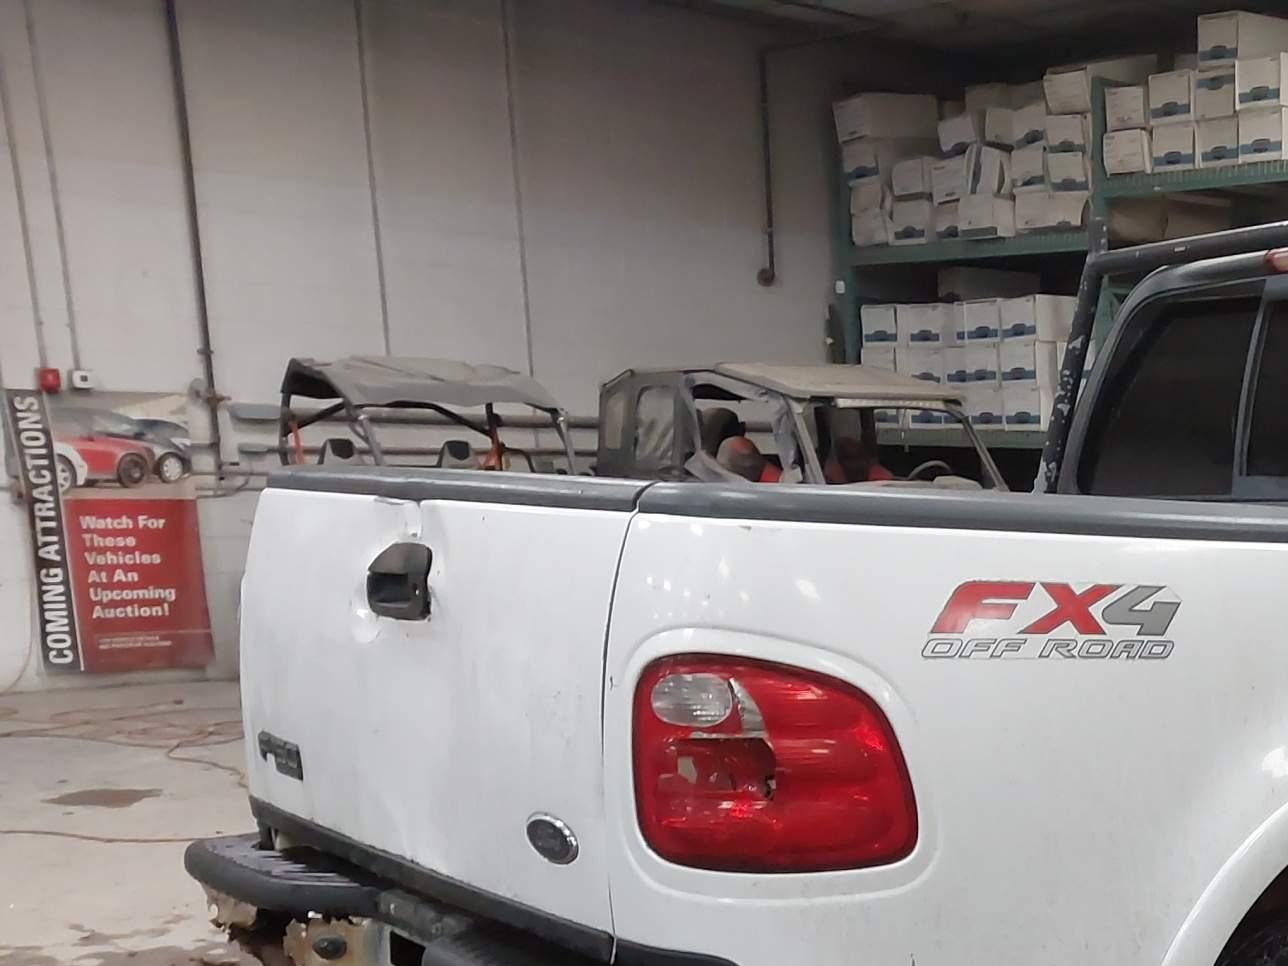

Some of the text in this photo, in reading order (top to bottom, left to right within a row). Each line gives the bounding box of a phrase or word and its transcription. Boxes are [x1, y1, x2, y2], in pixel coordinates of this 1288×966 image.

[15, 396, 73, 664] COMING ATTRACTIONS
[80, 515, 166, 529] Watch For
[82, 533, 136, 547] These
[84, 551, 161, 565] Vehicles
[88, 568, 139, 583] At An
[89, 586, 176, 603] Upcoming
[92, 602, 170, 619] Auction!
[929, 579, 1183, 637] FX4
[920, 637, 1176, 660] OFF ROAD
